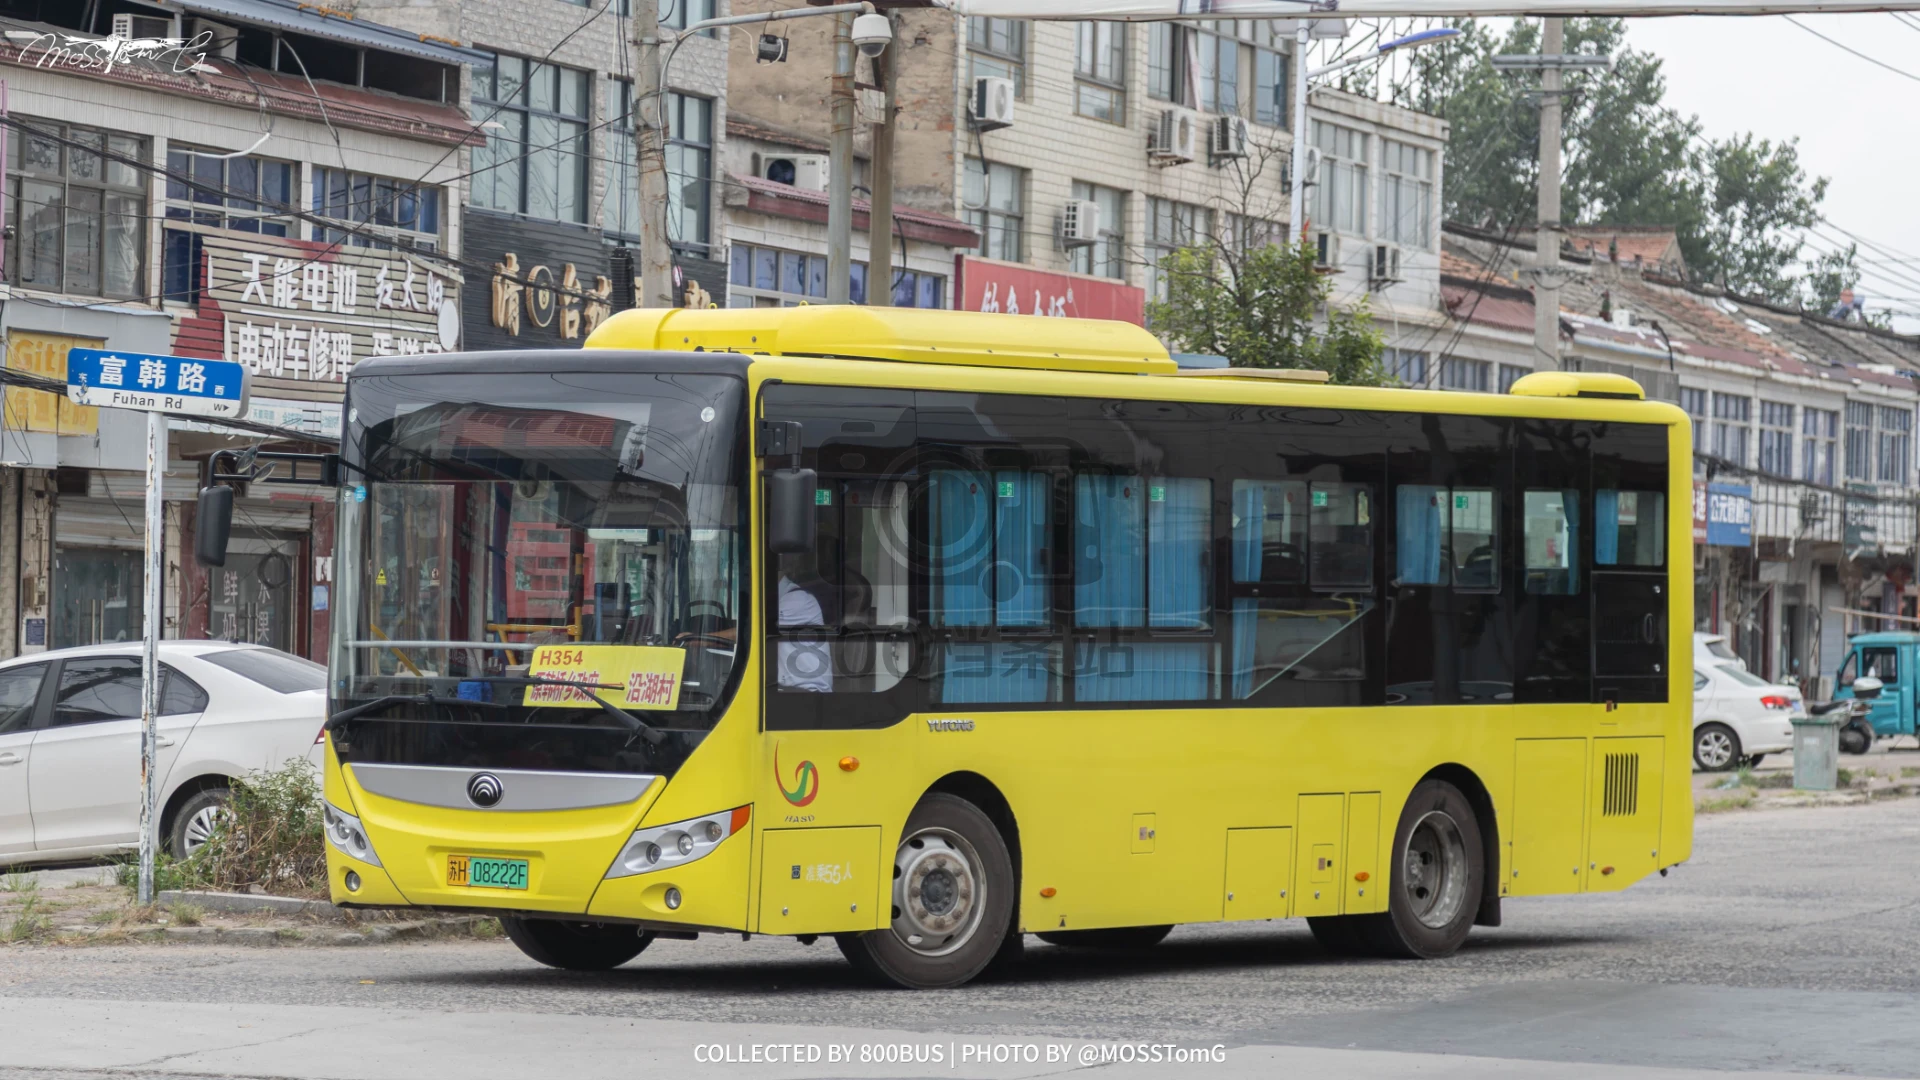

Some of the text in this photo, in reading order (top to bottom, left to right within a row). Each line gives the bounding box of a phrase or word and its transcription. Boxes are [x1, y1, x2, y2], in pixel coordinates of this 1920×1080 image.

[240, 252, 357, 314] 天能电池
[237, 320, 352, 384] 电动车修理
[99, 355, 207, 393] 富韩路
[214, 384, 225, 396] 西
[112, 392, 182, 409] Fuhan Rd
[213, 403, 224, 412] W
[539, 650, 583, 666] H354
[625, 672, 676, 706] 沿湖村
[926, 719, 976, 732] YUTONG
